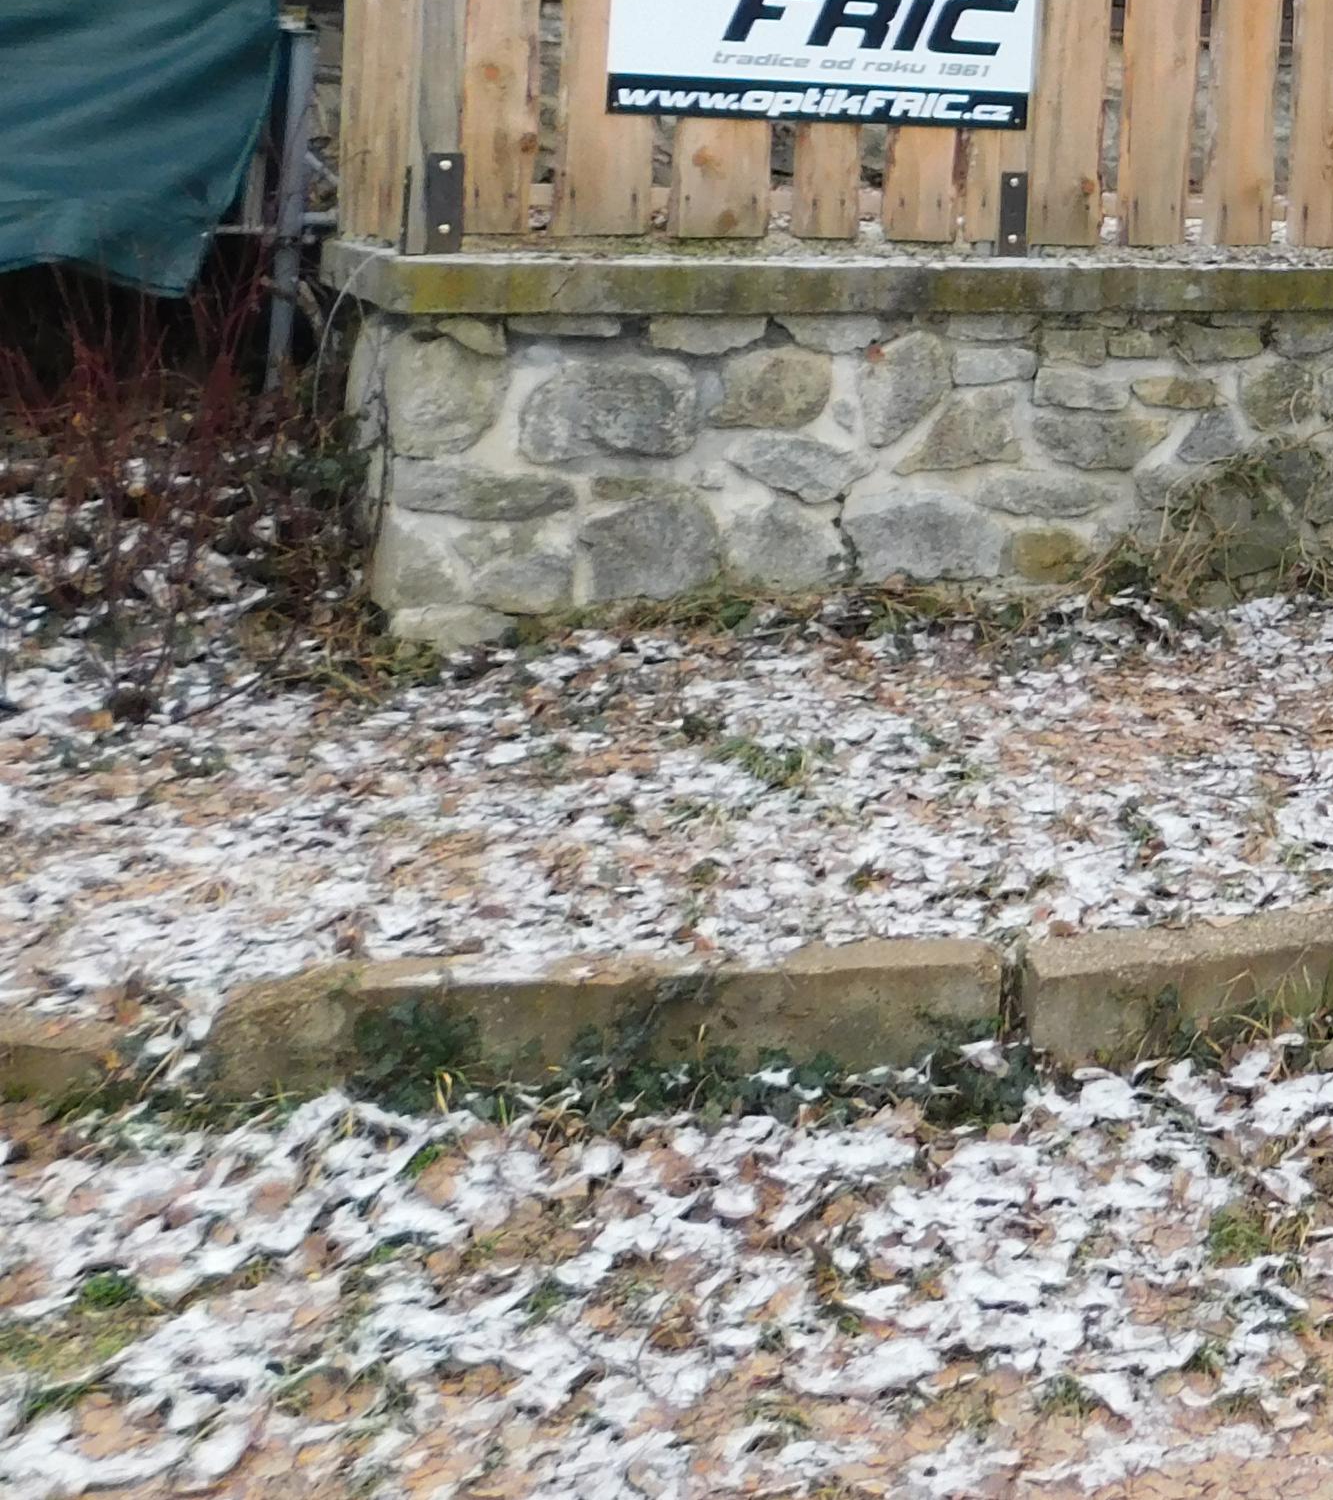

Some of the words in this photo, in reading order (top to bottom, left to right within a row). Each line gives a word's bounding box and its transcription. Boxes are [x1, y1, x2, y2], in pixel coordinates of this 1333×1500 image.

[712, 50, 810, 69] tradice
[819, 57, 857, 71] od
[861, 60, 927, 75] roku
[938, 62, 992, 78] 1961
[616, 86, 1014, 122] www.optikFRIC.cz
